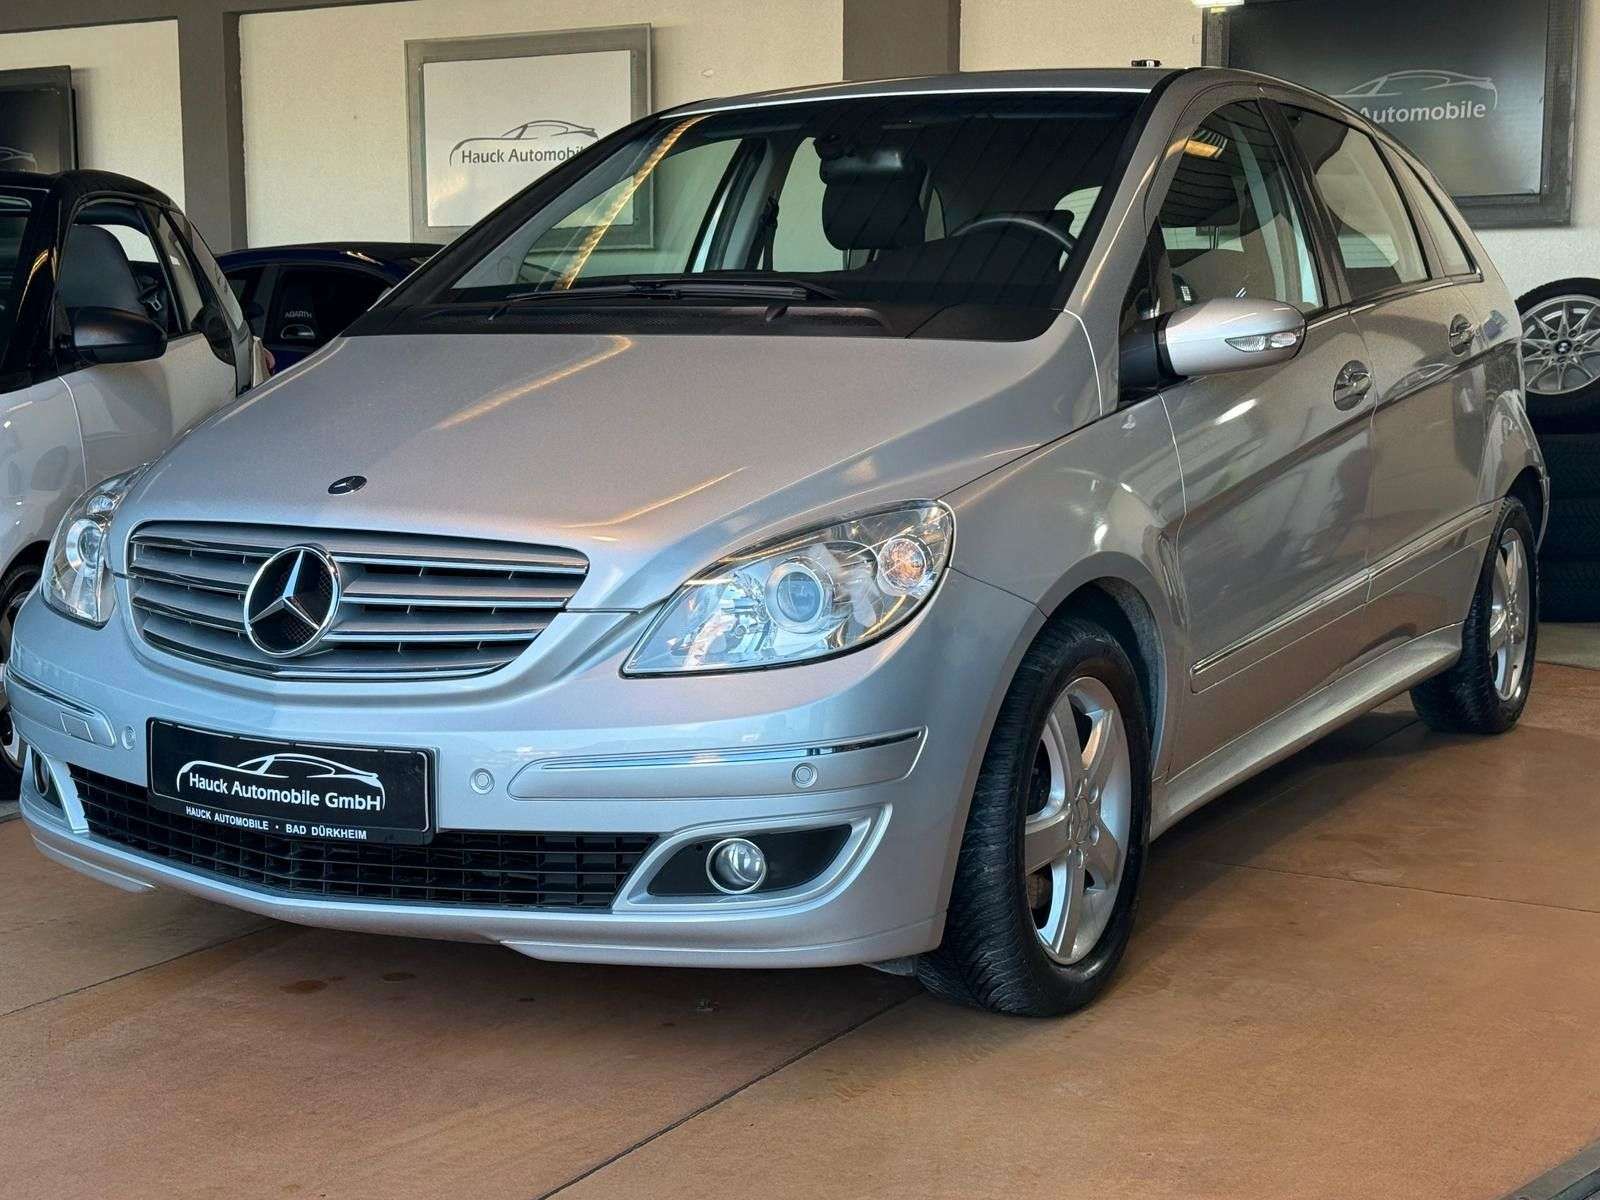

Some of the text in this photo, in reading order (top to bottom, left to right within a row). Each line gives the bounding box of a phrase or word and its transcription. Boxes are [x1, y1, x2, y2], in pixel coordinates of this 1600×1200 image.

[1359, 101, 1487, 124] Automobile
[461, 149, 505, 164] Hauck
[189, 772, 381, 811] Hauck Automobile GmbH
[186, 805, 368, 840] HAUCK AUTOMOBILE BAD DÜRKHEIM
